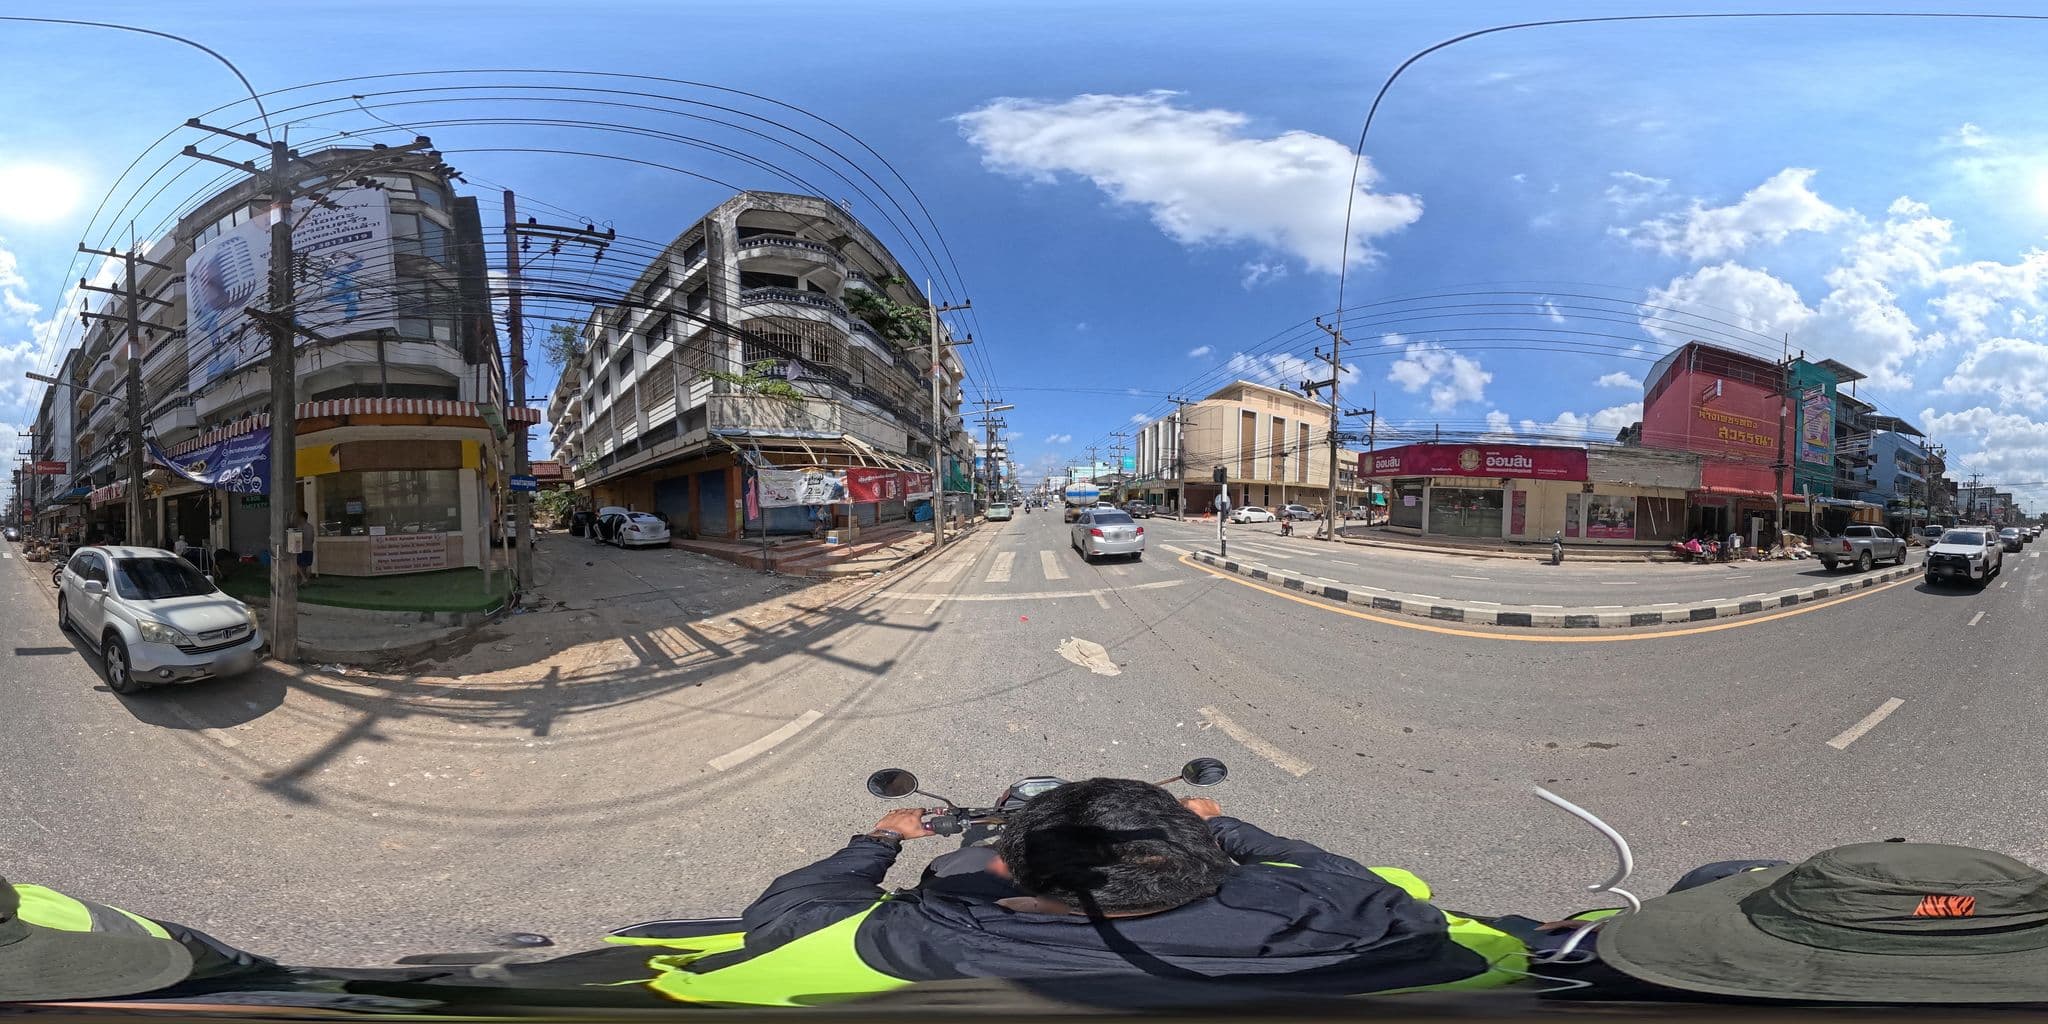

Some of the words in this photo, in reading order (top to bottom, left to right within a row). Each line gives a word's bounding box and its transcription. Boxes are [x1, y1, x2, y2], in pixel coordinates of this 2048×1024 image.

[344, 203, 369, 211] KTV
[1718, 426, 1774, 447] สุวรรณา
[1375, 456, 1401, 469] ออมสิน
[1486, 455, 1533, 468] ออมสิน
